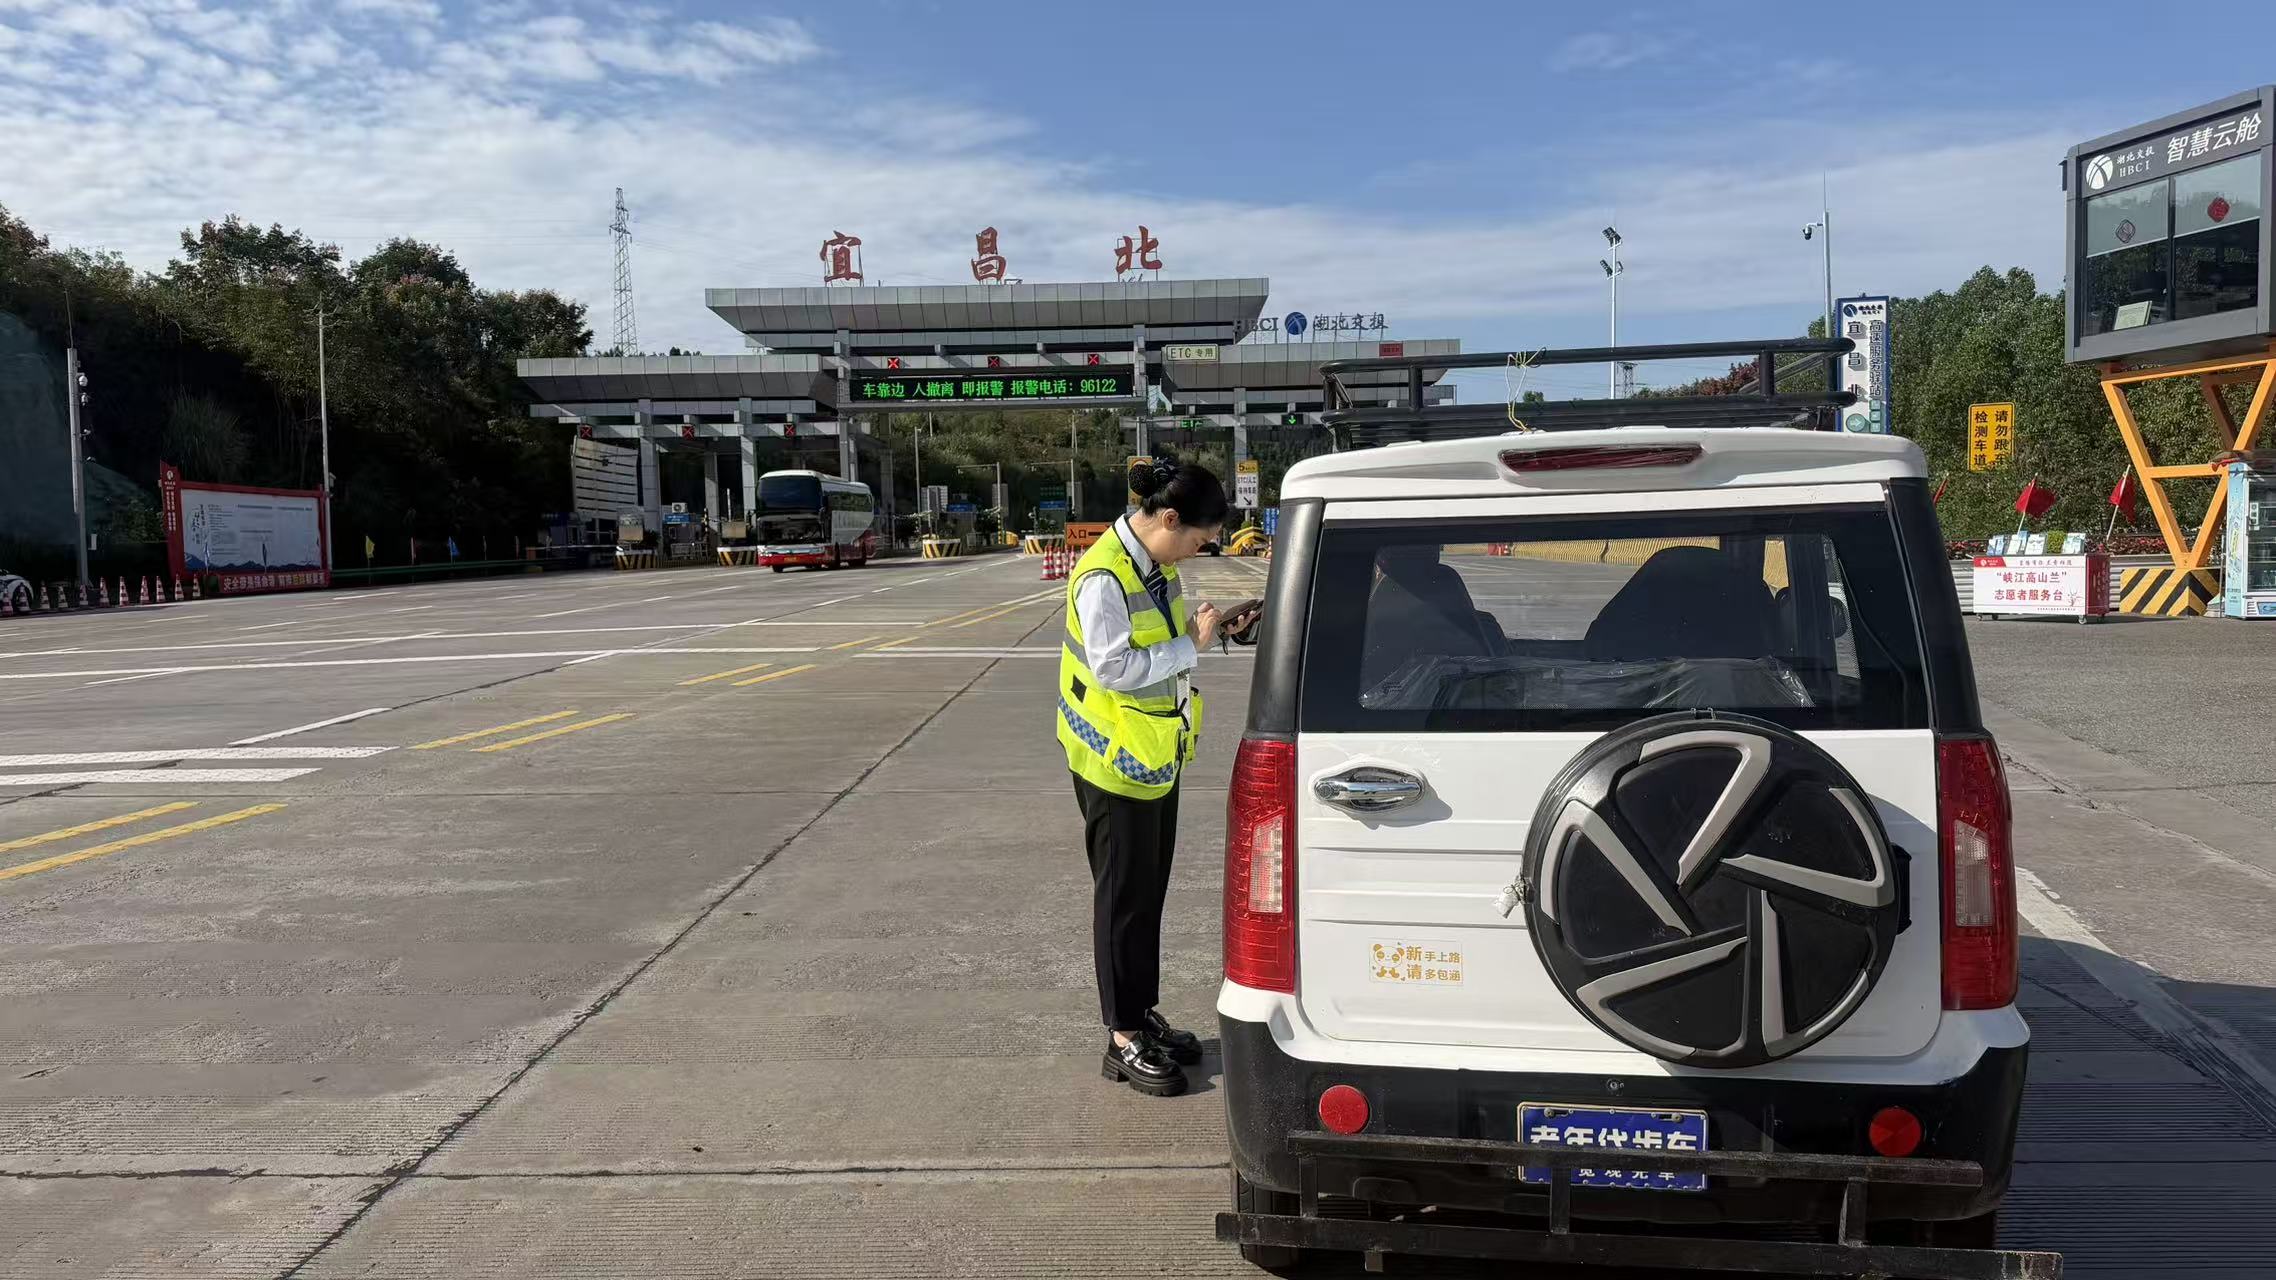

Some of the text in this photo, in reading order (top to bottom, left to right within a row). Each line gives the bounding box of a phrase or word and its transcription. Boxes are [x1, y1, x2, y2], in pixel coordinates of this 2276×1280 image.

[2167, 112, 2262, 165] 智慧云舱
[2117, 146, 2155, 165] 湖北交投
[2119, 160, 2151, 178] HBCI
[820, 225, 1163, 281] 宜昌北
[1313, 311, 1388, 331] 湖北交投
[1171, 347, 1191, 358] ETC
[1868, 319, 1882, 397] 高速服务驿站
[863, 382, 904, 398] 车靠边
[912, 381, 953, 397] 人撤离
[962, 380, 1003, 396] 即报警
[1974, 410, 1988, 469] 检测车道
[1994, 410, 2010, 465] 请勿跟车
[1068, 528, 1087, 539] 入口
[1994, 588, 2063, 601] 志愿者服务台
[1406, 945, 1461, 963] 新手上路
[1406, 963, 1461, 981] 请多包涵
[1530, 1125, 1698, 1151] 老年代步车
